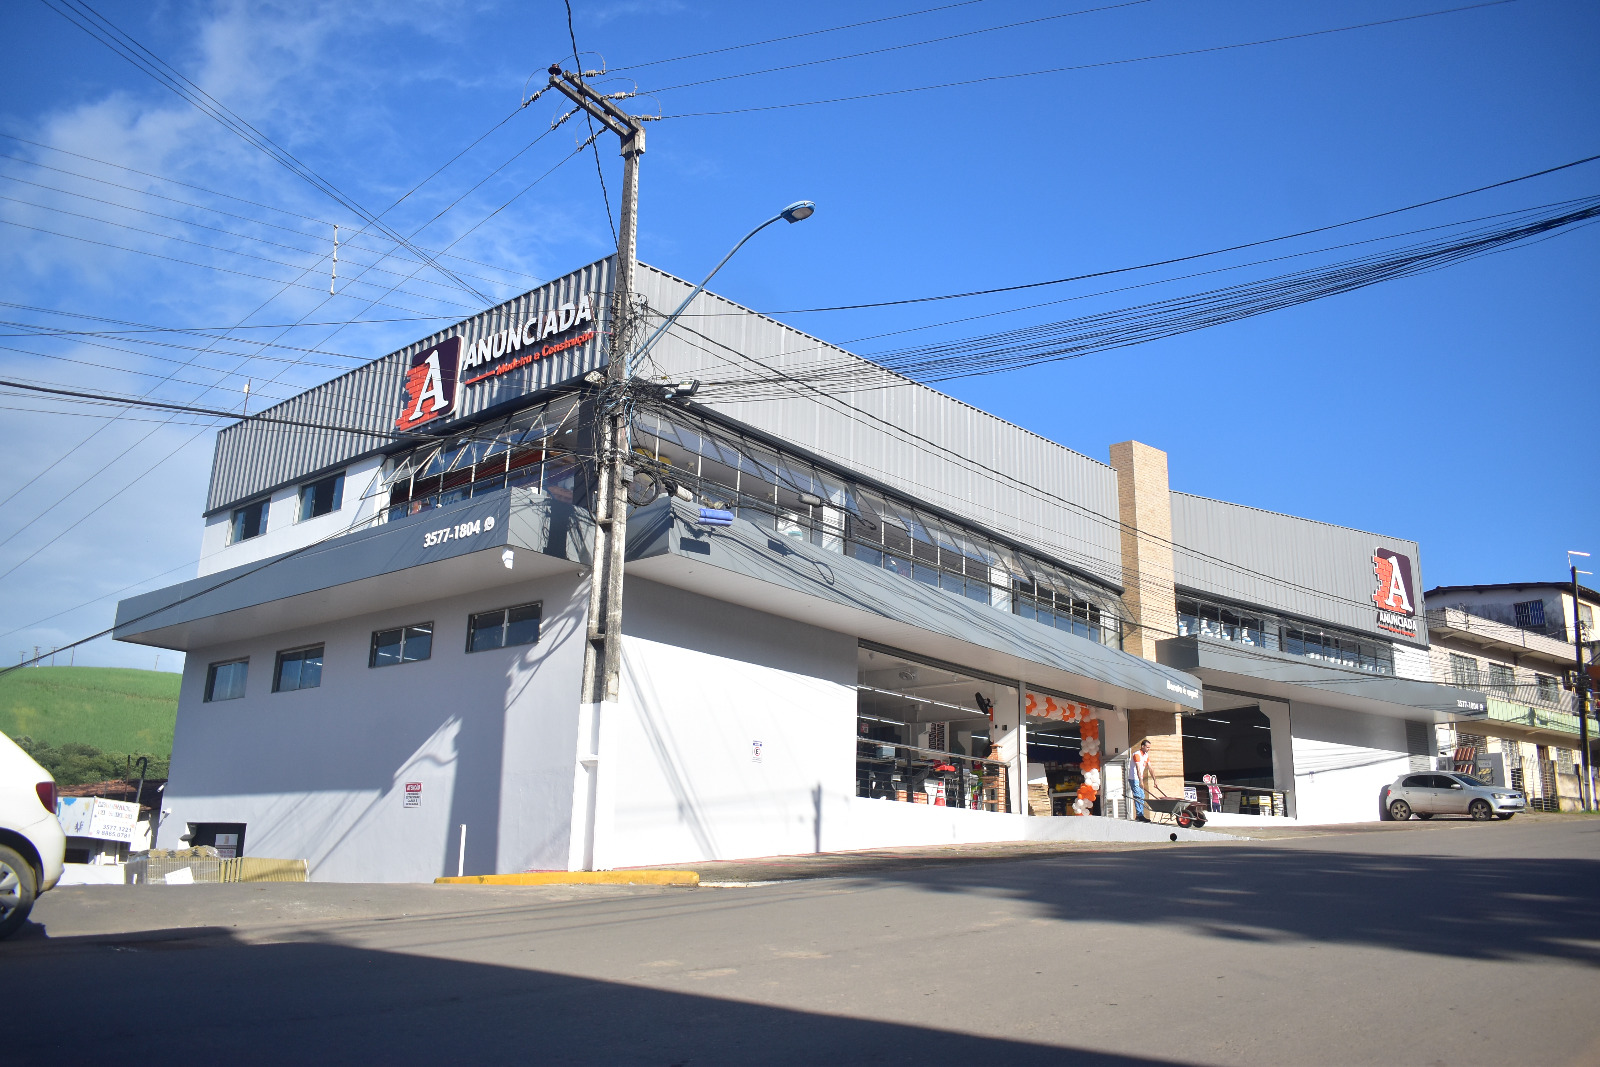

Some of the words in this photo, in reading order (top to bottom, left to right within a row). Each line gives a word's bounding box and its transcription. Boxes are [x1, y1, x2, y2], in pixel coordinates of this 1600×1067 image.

[463, 295, 592, 371] ANUNCIADA
[496, 355, 533, 376] Madeira
[534, 352, 540, 360] e
[542, 331, 594, 357] Construção
[408, 349, 449, 422] A
[423, 519, 481, 548] 3577-1804
[1384, 555, 1414, 613] A
[1379, 611, 1418, 632] ANUNCIADA
